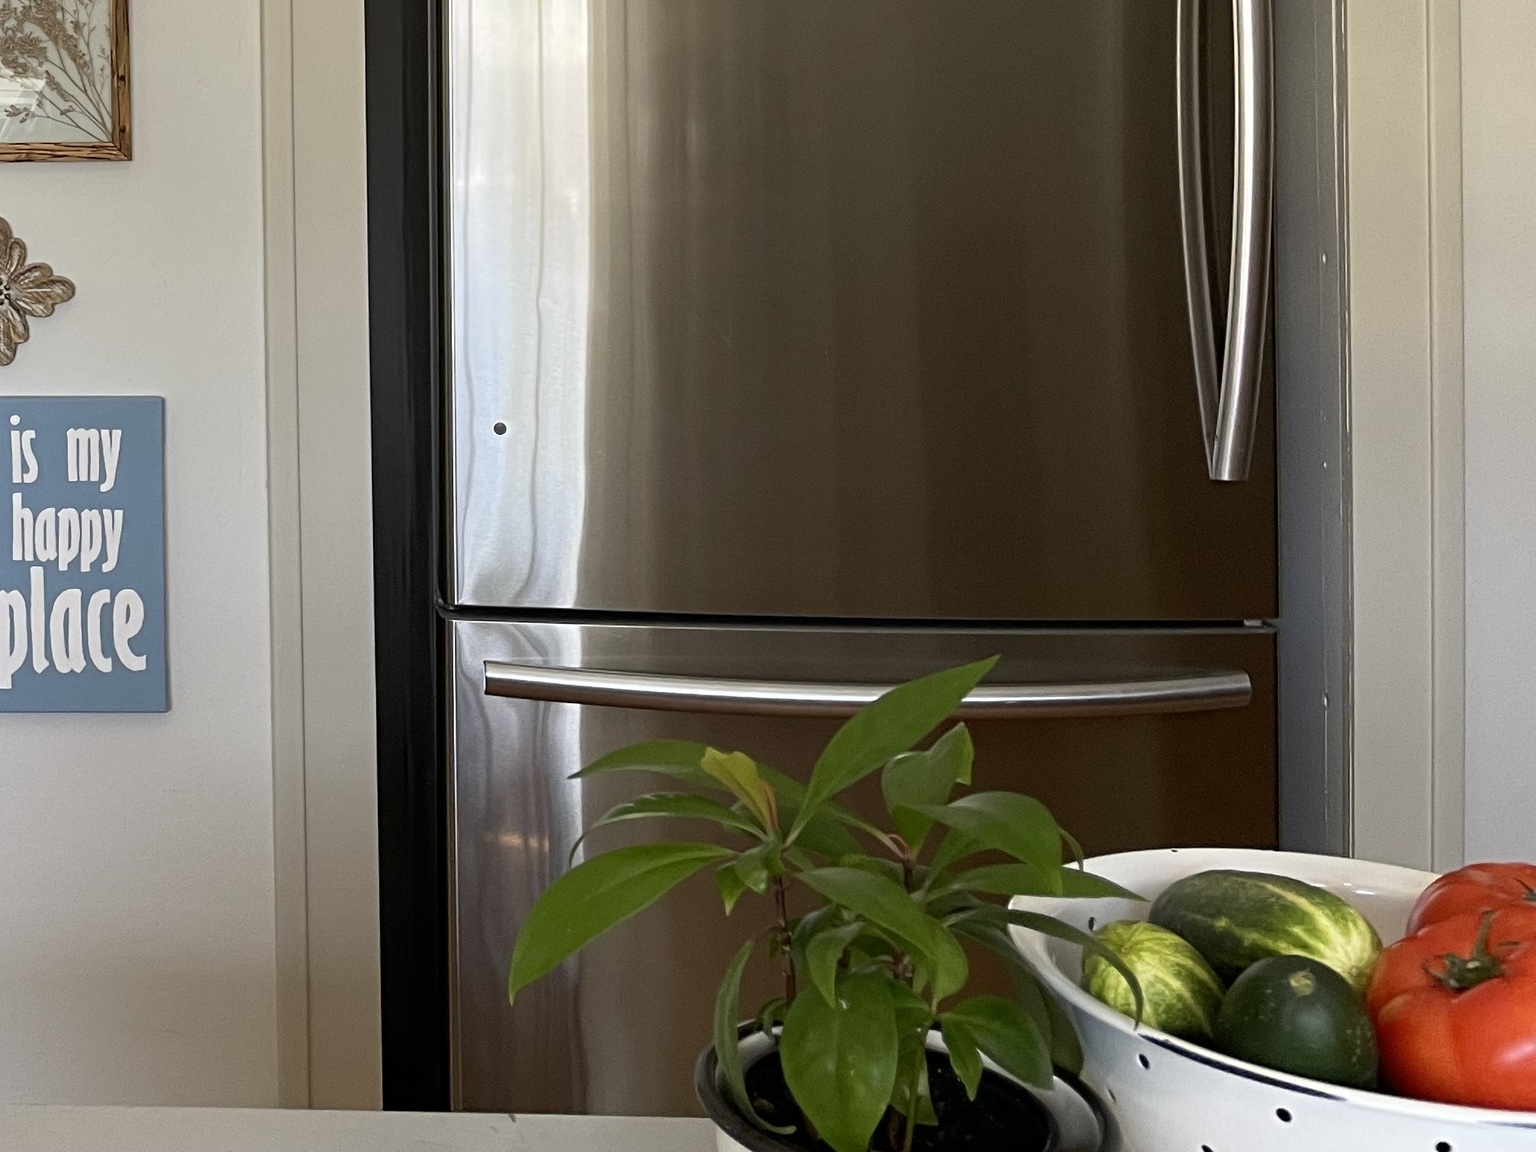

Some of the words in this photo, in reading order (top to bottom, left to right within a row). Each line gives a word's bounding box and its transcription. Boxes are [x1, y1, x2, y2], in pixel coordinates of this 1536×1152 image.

[9, 414, 39, 484] is
[66, 427, 123, 493] my
[12, 492, 124, 573] happy
